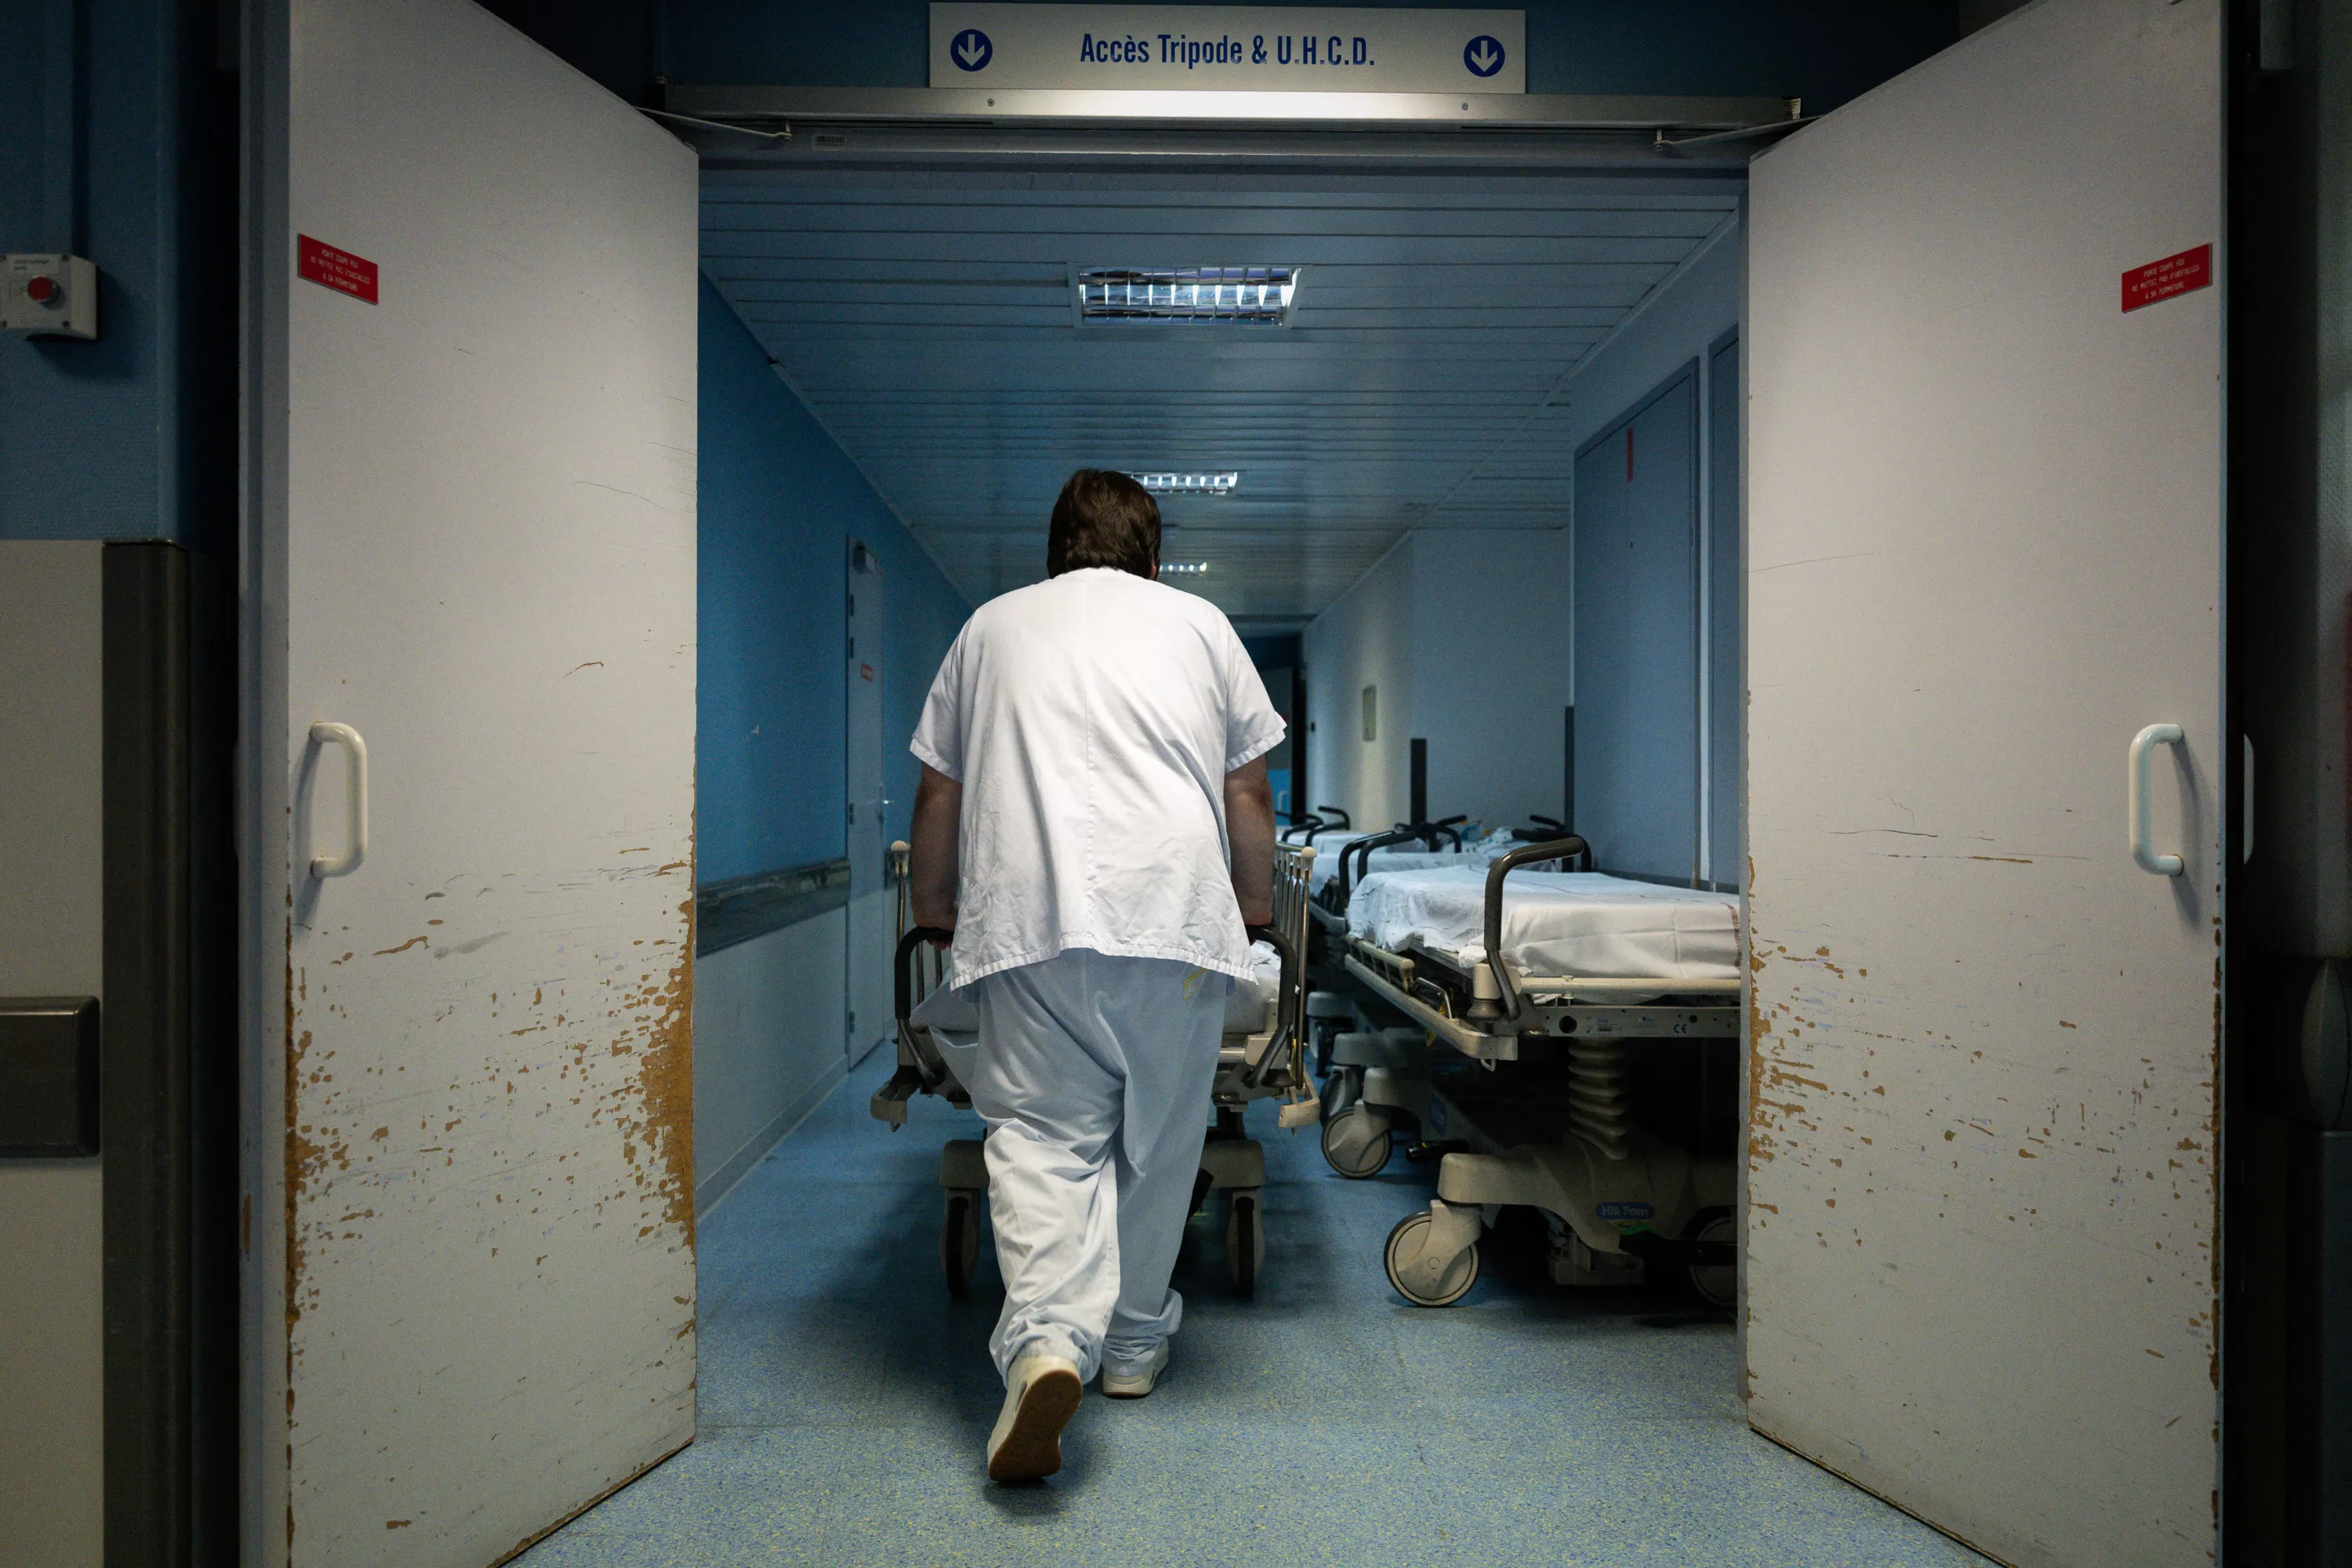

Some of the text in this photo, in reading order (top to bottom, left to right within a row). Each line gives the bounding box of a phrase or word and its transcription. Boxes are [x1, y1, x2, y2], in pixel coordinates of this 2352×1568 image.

[1080, 34, 1374, 69] Accès Tripode & U.H.C.D.
[1674, 1024, 1687, 1033] CE
